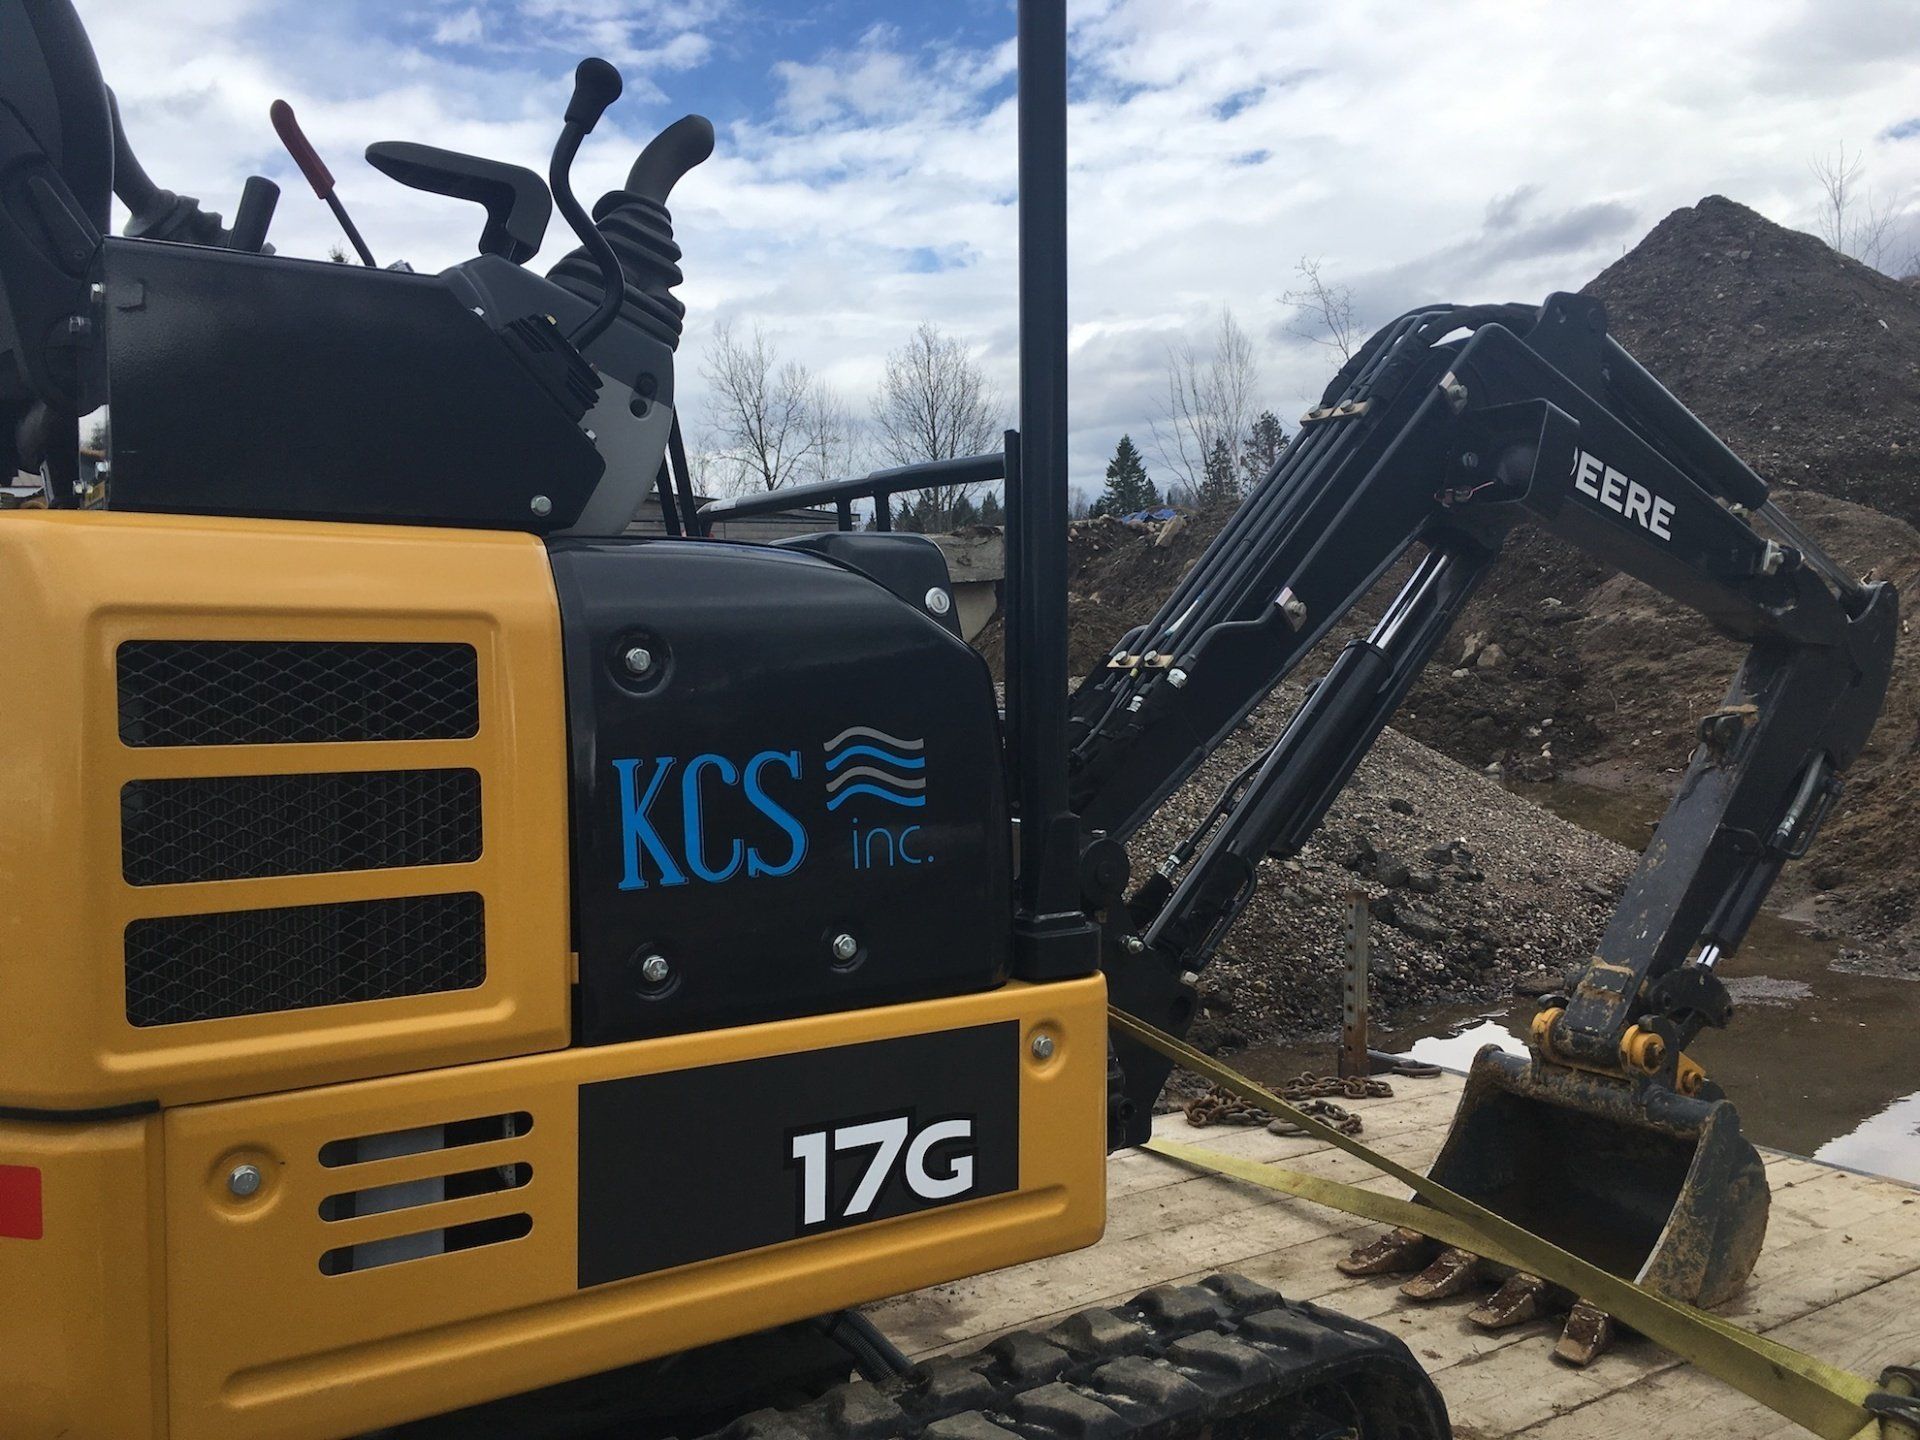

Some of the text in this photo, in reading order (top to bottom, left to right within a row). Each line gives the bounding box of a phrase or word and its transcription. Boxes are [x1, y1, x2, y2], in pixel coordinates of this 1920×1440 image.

[1570, 447, 1676, 541] EERE
[612, 750, 934, 891] KCS inc.
[792, 1116, 973, 1226] 17G
